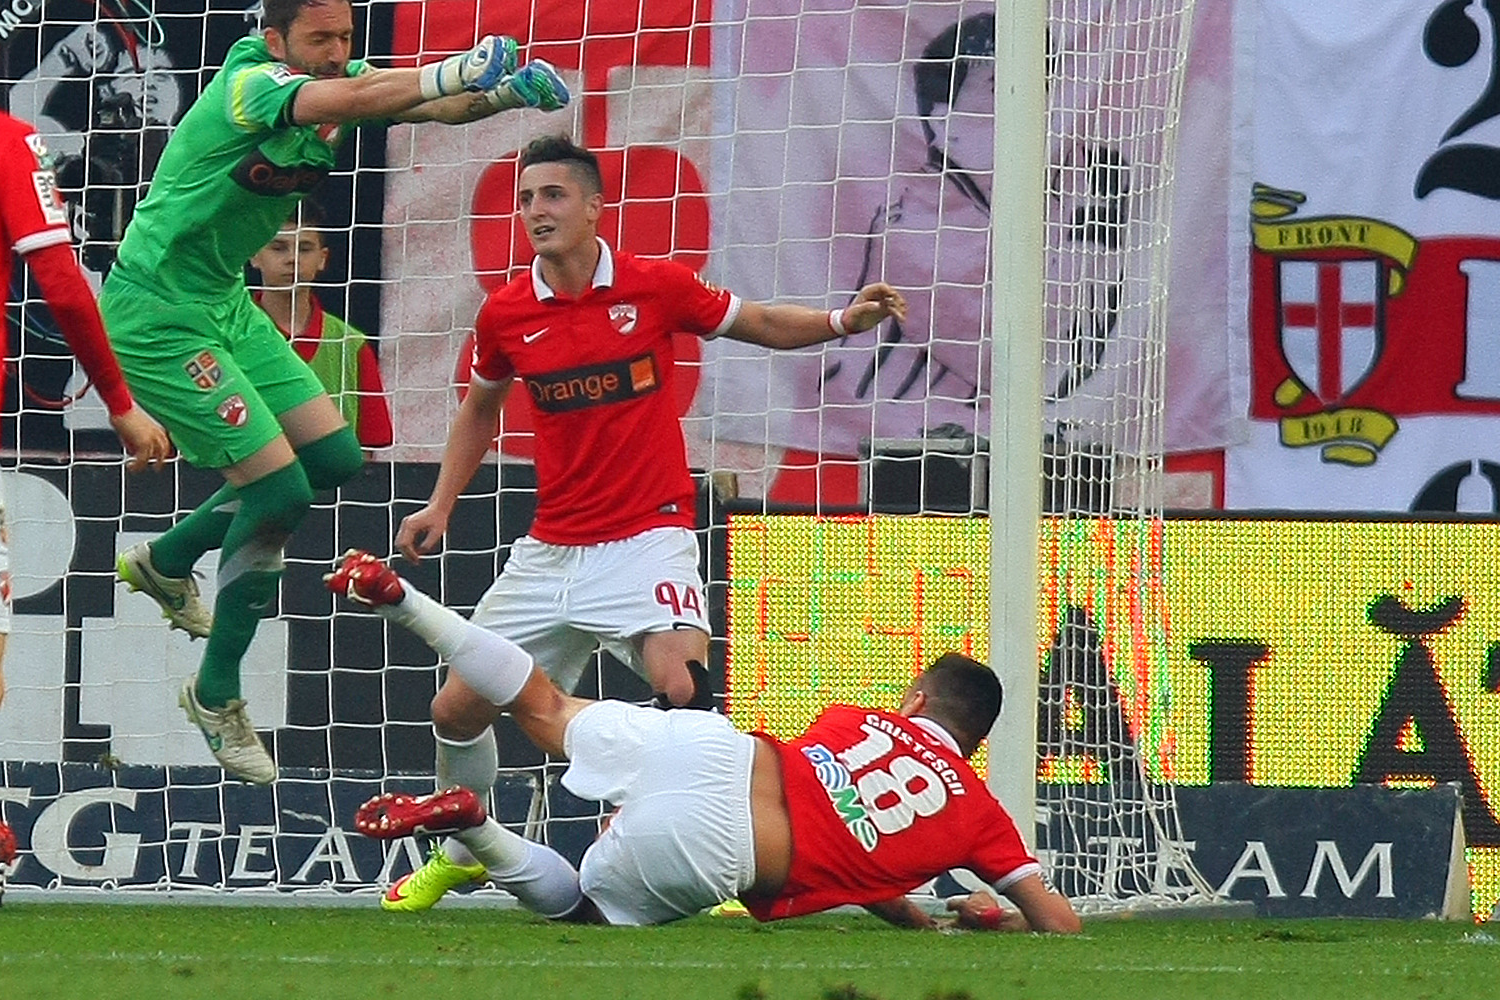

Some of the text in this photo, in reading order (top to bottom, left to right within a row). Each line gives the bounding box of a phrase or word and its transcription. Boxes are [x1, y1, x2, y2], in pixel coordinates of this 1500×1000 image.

[1277, 224, 1371, 247] FRONT
[653, 579, 702, 620] 94
[835, 722, 948, 834] 18
